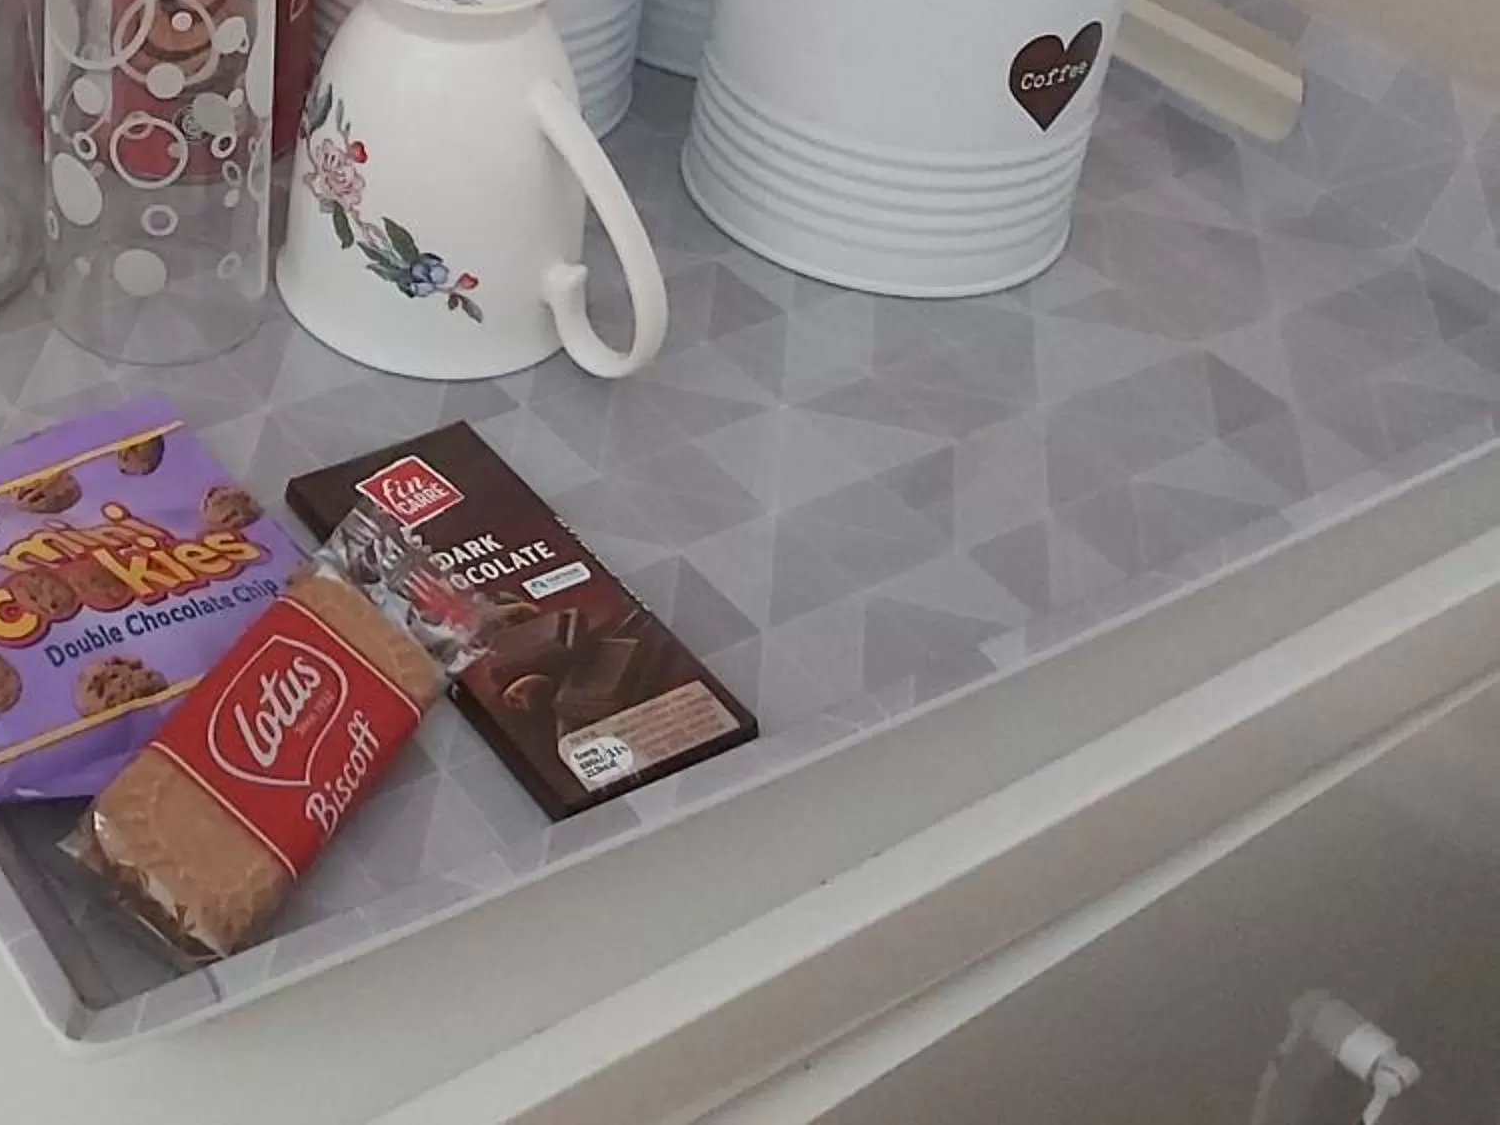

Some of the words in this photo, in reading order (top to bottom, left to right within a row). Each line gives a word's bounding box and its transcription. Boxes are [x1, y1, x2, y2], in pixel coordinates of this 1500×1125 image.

[1021, 60, 1088, 90] Coffee
[431, 534, 504, 572] DARK
[450, 541, 556, 591] OCOLATE
[44, 620, 124, 668] Double
[124, 588, 234, 637] Chocolate
[233, 576, 280, 603] Chip
[305, 710, 381, 838] Biscoff
